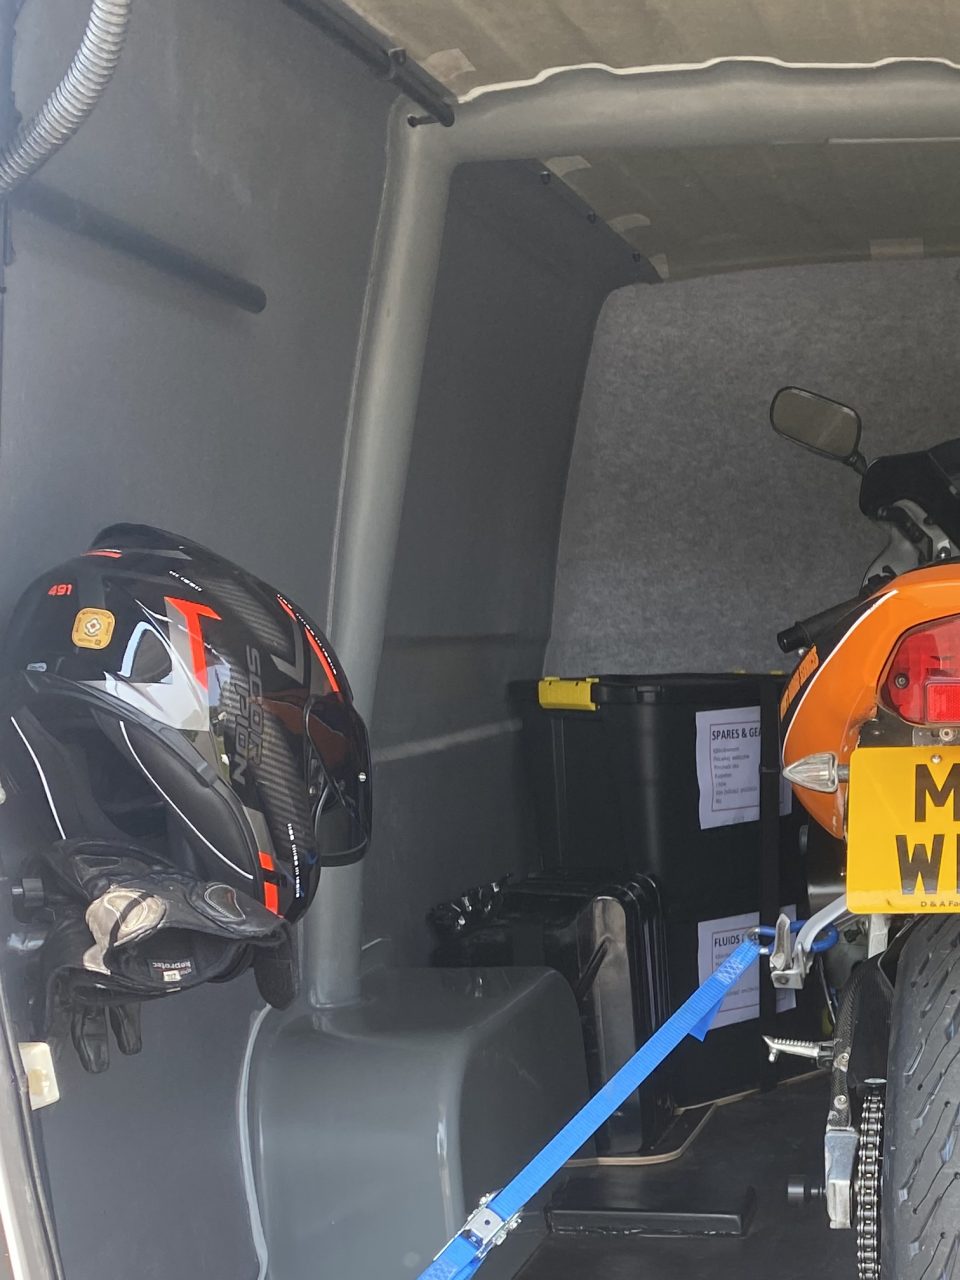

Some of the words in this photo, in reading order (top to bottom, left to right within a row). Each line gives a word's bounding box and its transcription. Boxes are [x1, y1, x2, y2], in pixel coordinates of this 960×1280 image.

[48, 582, 73, 596] 491
[246, 645, 263, 766] SCOR
[232, 682, 250, 785] PION
[712, 729, 740, 741] SPARES
[741, 727, 748, 738] &
[714, 934, 740, 948] FLUIDS
